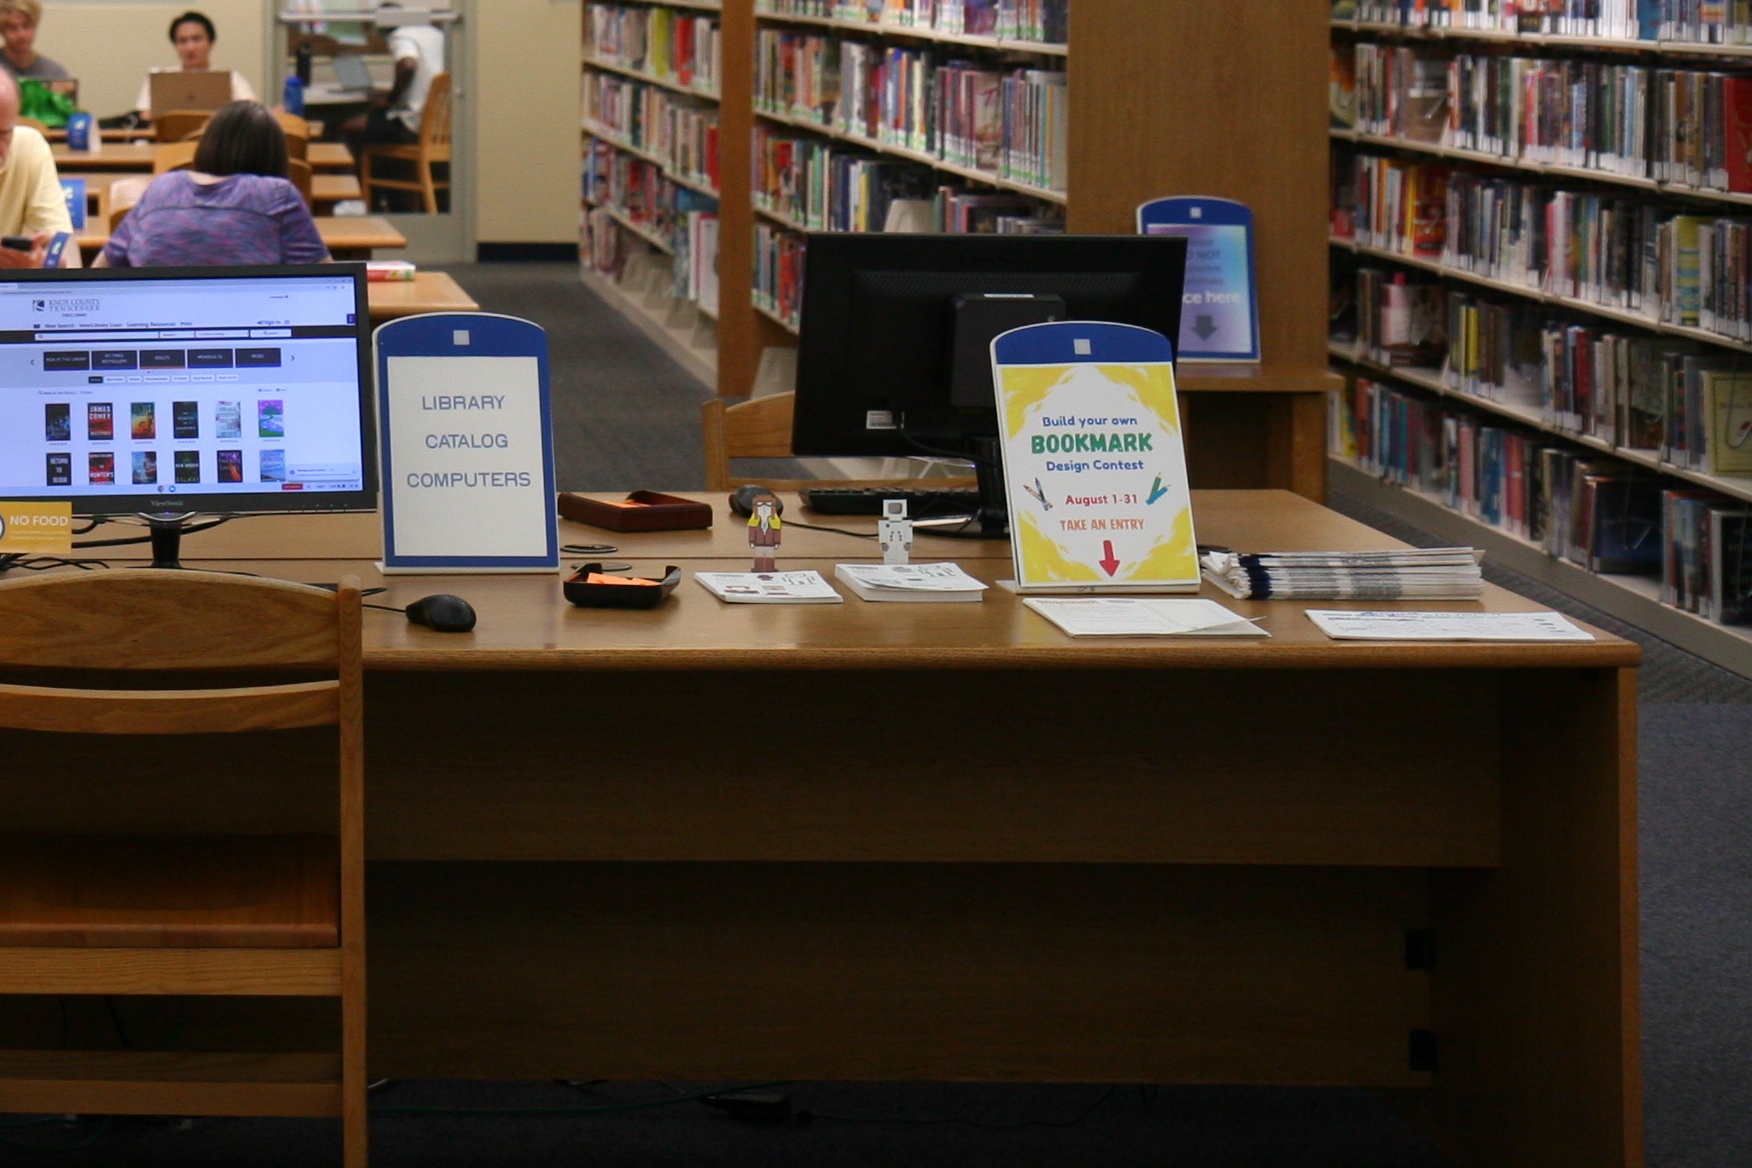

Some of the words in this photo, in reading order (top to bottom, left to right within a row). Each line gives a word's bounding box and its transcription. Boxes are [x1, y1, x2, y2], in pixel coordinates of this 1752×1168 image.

[48, 304, 101, 312] TENNESSEE
[71, 298, 100, 306] COUNTY
[126, 321, 149, 330] Learning
[149, 320, 177, 328] Resources
[89, 405, 111, 413] JAMES
[421, 394, 506, 412] LIBRARY
[89, 412, 111, 420] COMEY
[1041, 415, 1076, 428] Build
[1078, 416, 1109, 429] your
[1111, 416, 1138, 427] own
[424, 433, 509, 449] CATALOG
[1030, 432, 1154, 455] BOOKMARK
[1045, 459, 1090, 474] Design
[1092, 459, 1144, 472] Contest
[405, 471, 532, 488] COMPUTERS
[1064, 493, 1109, 507] August
[1111, 493, 1138, 505] 1-31
[8, 514, 30, 527] NO
[32, 514, 69, 527] FOOD
[1059, 518, 1088, 532] TAKE
[1090, 518, 1107, 531] AN
[1109, 518, 1145, 531] ENTRY
